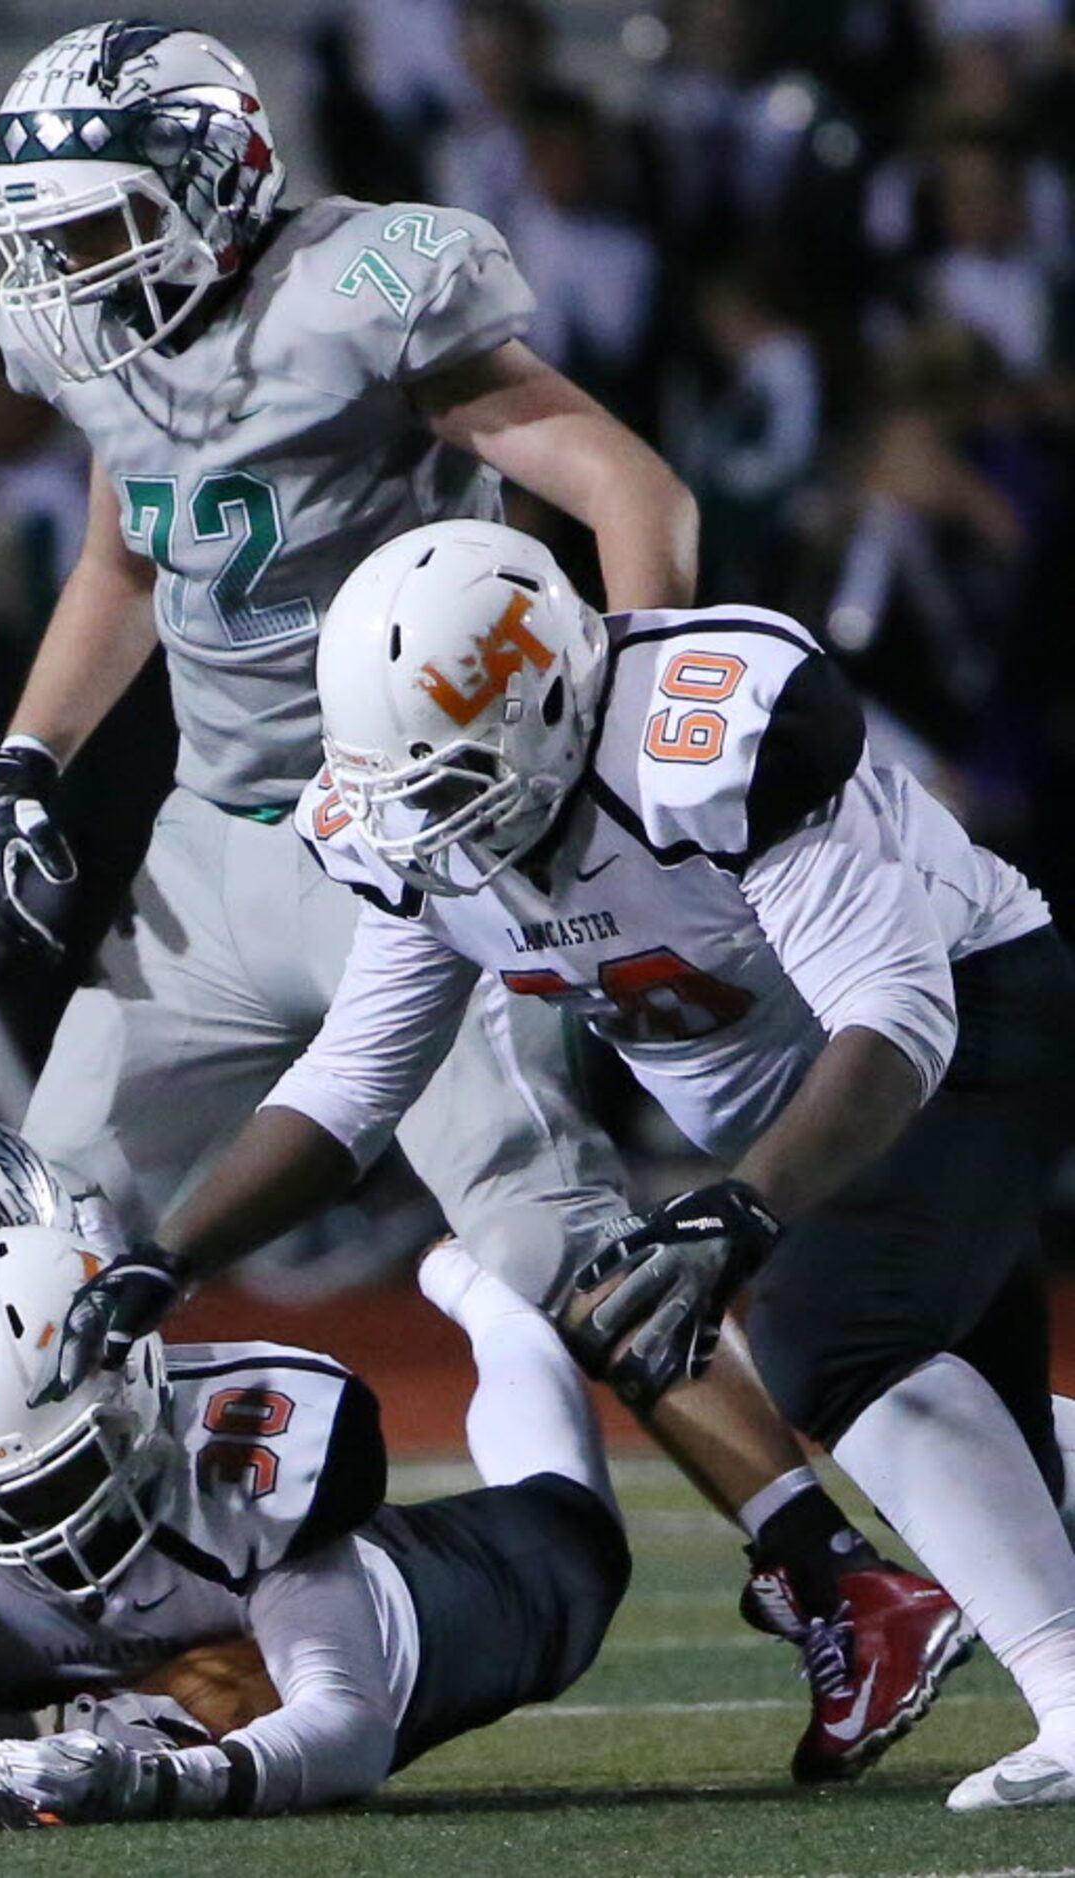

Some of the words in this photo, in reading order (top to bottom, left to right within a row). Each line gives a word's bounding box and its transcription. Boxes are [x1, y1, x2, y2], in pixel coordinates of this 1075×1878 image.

[333, 211, 473, 319] 72
[119, 469, 319, 647] 72
[644, 649, 748, 766] 60
[506, 910, 621, 953] LANCASTER
